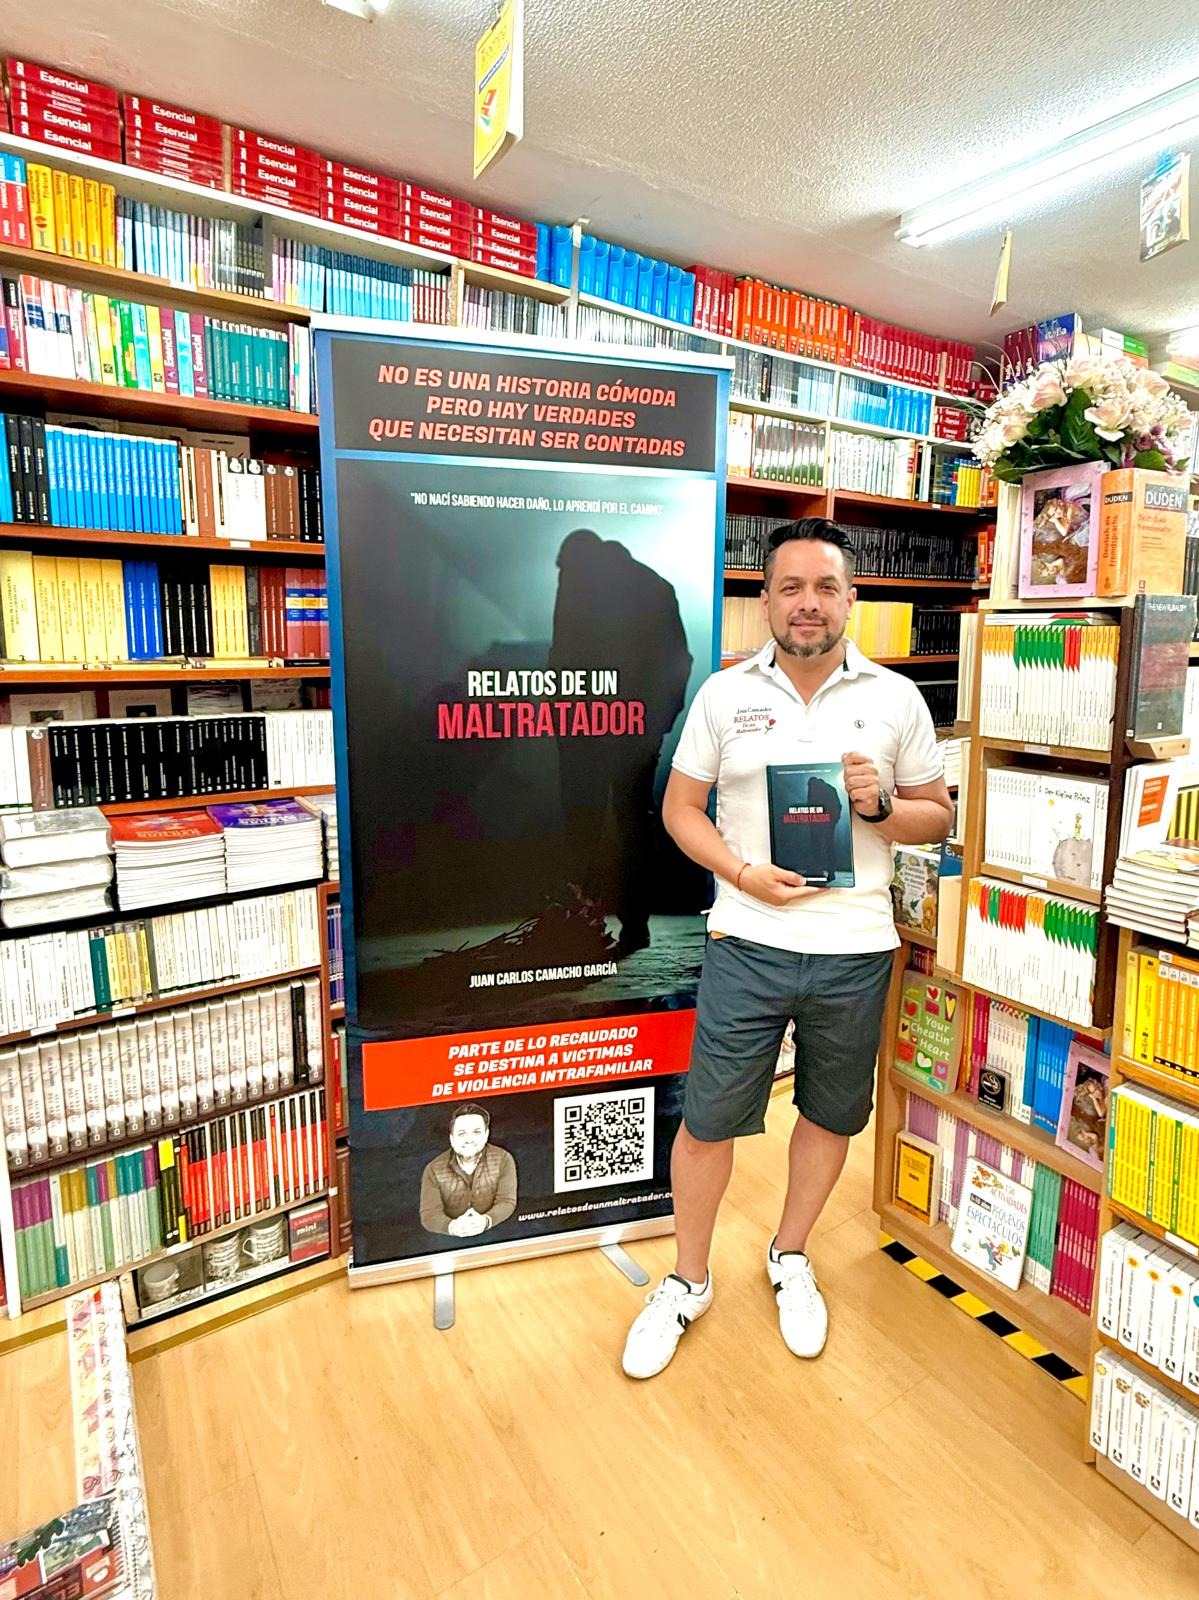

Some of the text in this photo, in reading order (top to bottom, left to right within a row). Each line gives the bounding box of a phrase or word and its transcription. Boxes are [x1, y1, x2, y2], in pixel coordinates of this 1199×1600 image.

[40, 70, 88, 94] Esencial
[43, 111, 91, 133] Esencial
[152, 105, 195, 124] Esencial
[44, 129, 92, 151] Esencial
[155, 122, 198, 142] Esencial
[257, 137, 295, 156] Esencial
[259, 154, 297, 173] Esencial
[258, 169, 296, 188] Esencial
[343, 168, 378, 185] Esencial
[343, 182, 377, 200] Esencial
[421, 191, 452, 208] Esencial
[344, 197, 378, 215] Esencial
[420, 206, 451, 222] Esencial
[344, 213, 377, 230] Esencial
[420, 220, 450, 237] Esencial
[492, 215, 520, 230] Esencial
[420, 235, 451, 251] Esencial
[491, 229, 520, 243] Esencial
[491, 256, 519, 270] Esencial
[162, 329, 174, 367] Esencial
[192, 334, 203, 371] Esencial
[378, 365, 677, 406] NO ES UNA HISTORIA CÓMODA
[427, 396, 636, 429] PERO HAY VERDADES
[370, 420, 686, 457] QUE NECESITAN SER CONTADAS
[429, 492, 452, 507] NACÍ
[452, 494, 496, 509] SABIENDO
[497, 496, 525, 510] HACER
[554, 499, 565, 511] LO
[566, 498, 601, 513] APRENDÍ
[602, 500, 618, 513] POR
[620, 501, 630, 513] EL
[1104, 495, 1128, 504] DUDEN
[1146, 491, 1182, 508] DUDEN
[468, 670, 618, 696] RELATOS DE UN
[438, 701, 646, 740] MALTRATADOR
[734, 714, 770, 723] RELATOS
[470, 961, 617, 988] JUAN CARLOS CAMACHO GARCÍA
[925, 1016, 950, 1031] Your
[449, 1026, 638, 1059] PARTE DE LO RECAUDADO
[910, 1022, 953, 1046] Cheatin'
[920, 1038, 950, 1061] Heart
[454, 1044, 634, 1076] SE DESTINA A VICTIMAS
[432, 1058, 653, 1097] DE VIOLENCIA INTRAFAMILIAR
[297, 1222, 317, 1235] mini
